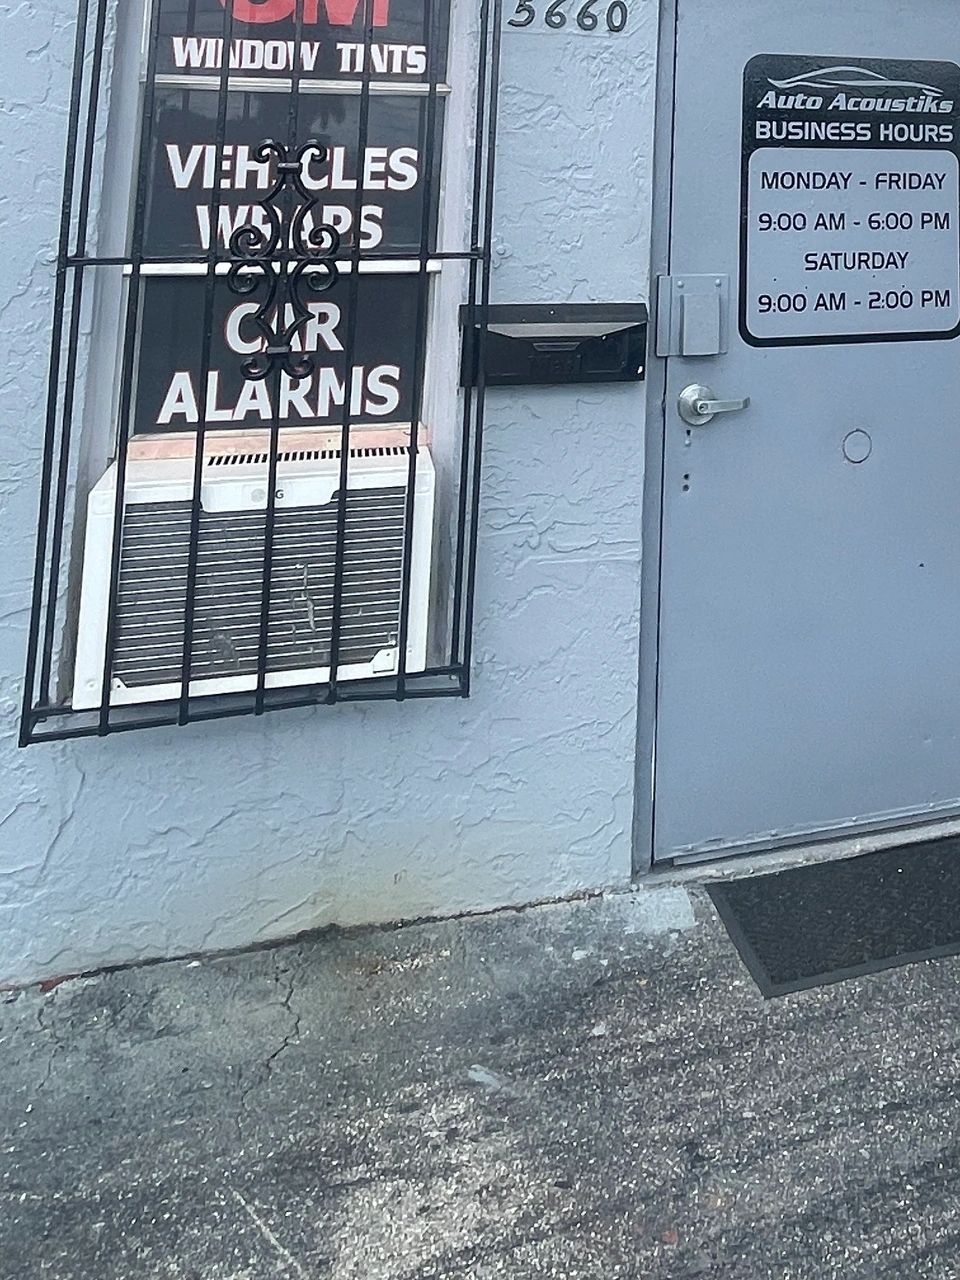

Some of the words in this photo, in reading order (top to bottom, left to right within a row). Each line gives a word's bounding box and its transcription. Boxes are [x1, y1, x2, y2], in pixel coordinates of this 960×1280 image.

[172, 37, 320, 71] WINDOW
[337, 43, 427, 74] TINTS
[757, 91, 823, 110] Auto
[828, 92, 953, 113] Acoustiks
[756, 121, 872, 141] BUSINESS
[880, 124, 953, 142] HOURS
[165, 144, 419, 190] VEHCLES
[761, 172, 852, 190] MONDAY
[875, 173, 946, 190] FRIDAY
[758, 213, 807, 231] 9:00
[814, 213, 845, 230] AM
[868, 213, 913, 230] 6:00
[921, 213, 950, 229] PM
[805, 252, 909, 271] SATURDAY
[758, 294, 807, 313] 9:00
[814, 292, 846, 311] AM
[868, 291, 913, 309] 2:00
[921, 290, 950, 308] PM
[225, 301, 344, 355] CAR
[156, 365, 400, 424] ALARMS
